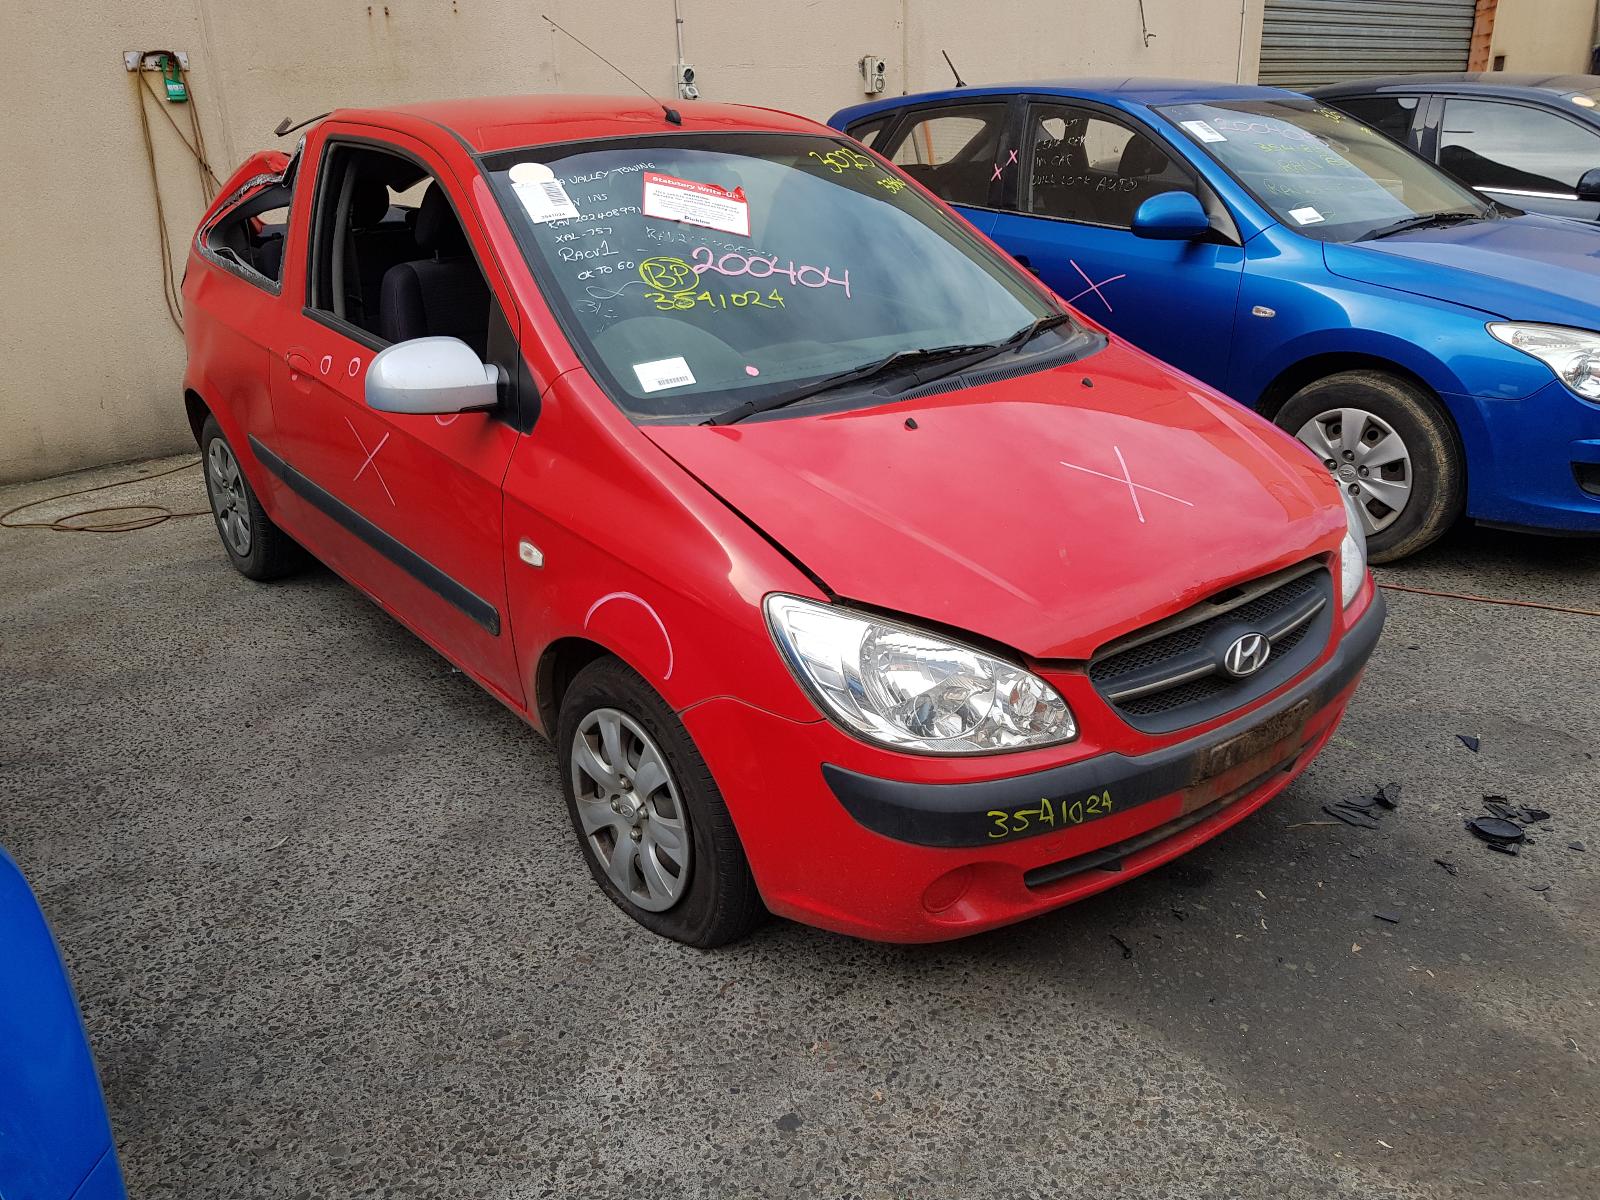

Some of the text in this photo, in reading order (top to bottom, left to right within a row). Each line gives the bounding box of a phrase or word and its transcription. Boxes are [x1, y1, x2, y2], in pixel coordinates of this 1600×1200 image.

[569, 171, 609, 184] VALLEY
[611, 162, 656, 175] TOWING
[588, 193, 608, 203] INS
[578, 270, 596, 280] OK
[595, 265, 613, 275] TO
[643, 262, 689, 288] BP
[692, 247, 851, 299] 200404
